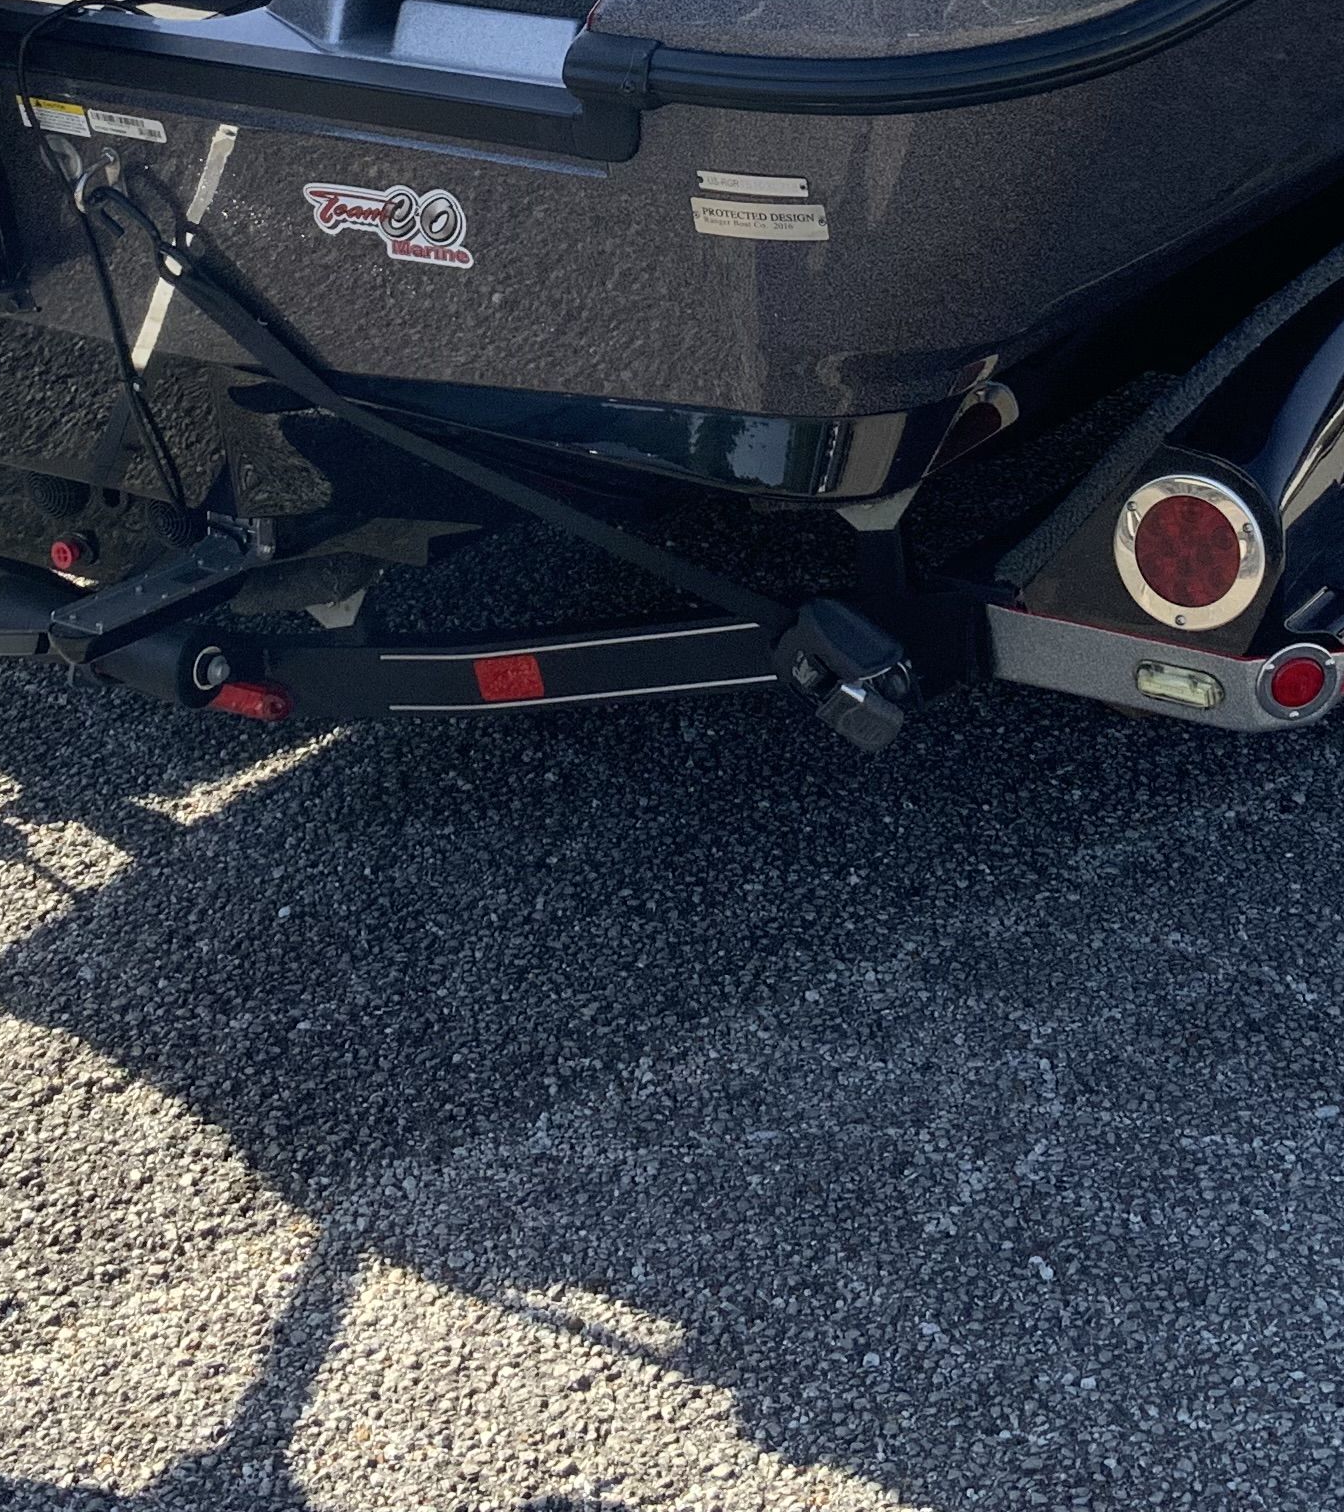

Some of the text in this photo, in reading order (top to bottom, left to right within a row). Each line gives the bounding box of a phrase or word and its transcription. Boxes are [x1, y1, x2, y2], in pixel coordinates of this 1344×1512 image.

[702, 207, 815, 223] PROTECTED DESIGN
[392, 240, 471, 265] Marine
